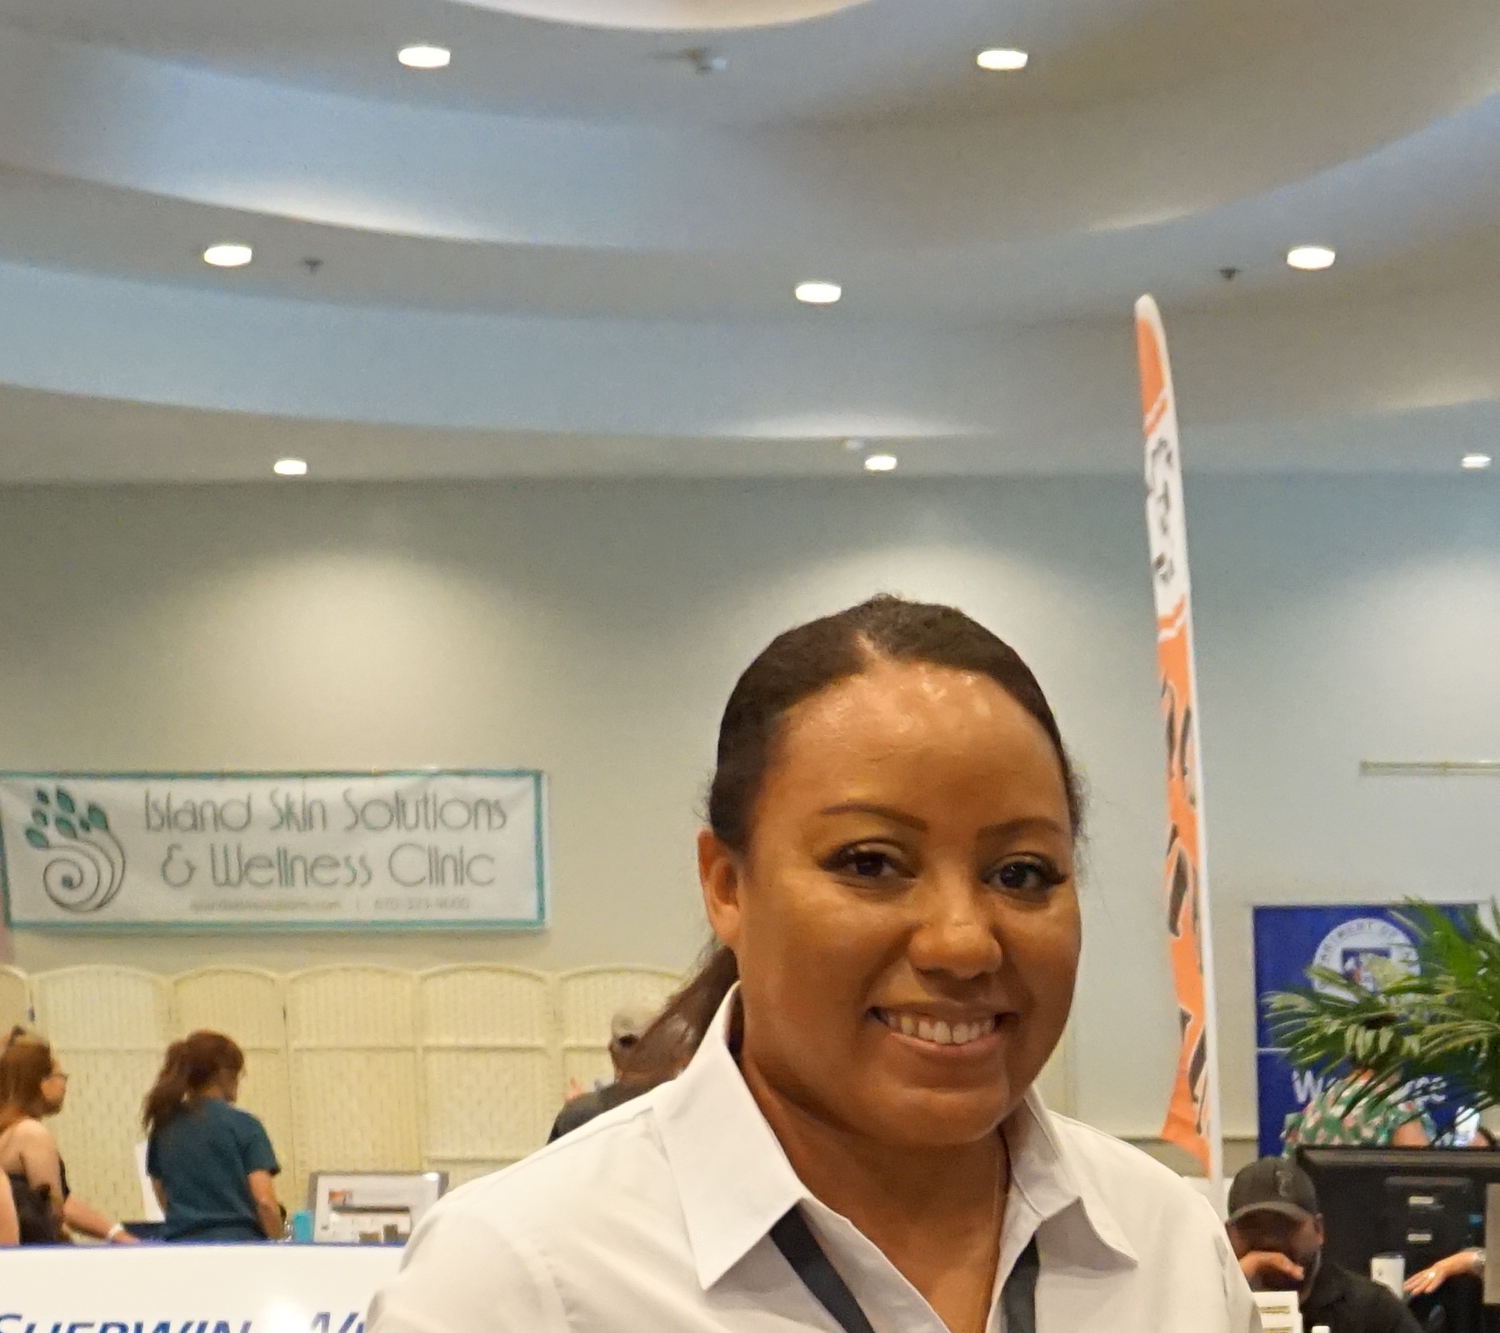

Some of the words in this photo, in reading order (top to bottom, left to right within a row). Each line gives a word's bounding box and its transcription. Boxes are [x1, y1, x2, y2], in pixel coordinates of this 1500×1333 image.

[143, 788, 252, 832] Island
[269, 792, 326, 832] Skin
[345, 788, 507, 832] Solutions
[211, 844, 373, 888] Wellness
[387, 843, 496, 888] Clinic
